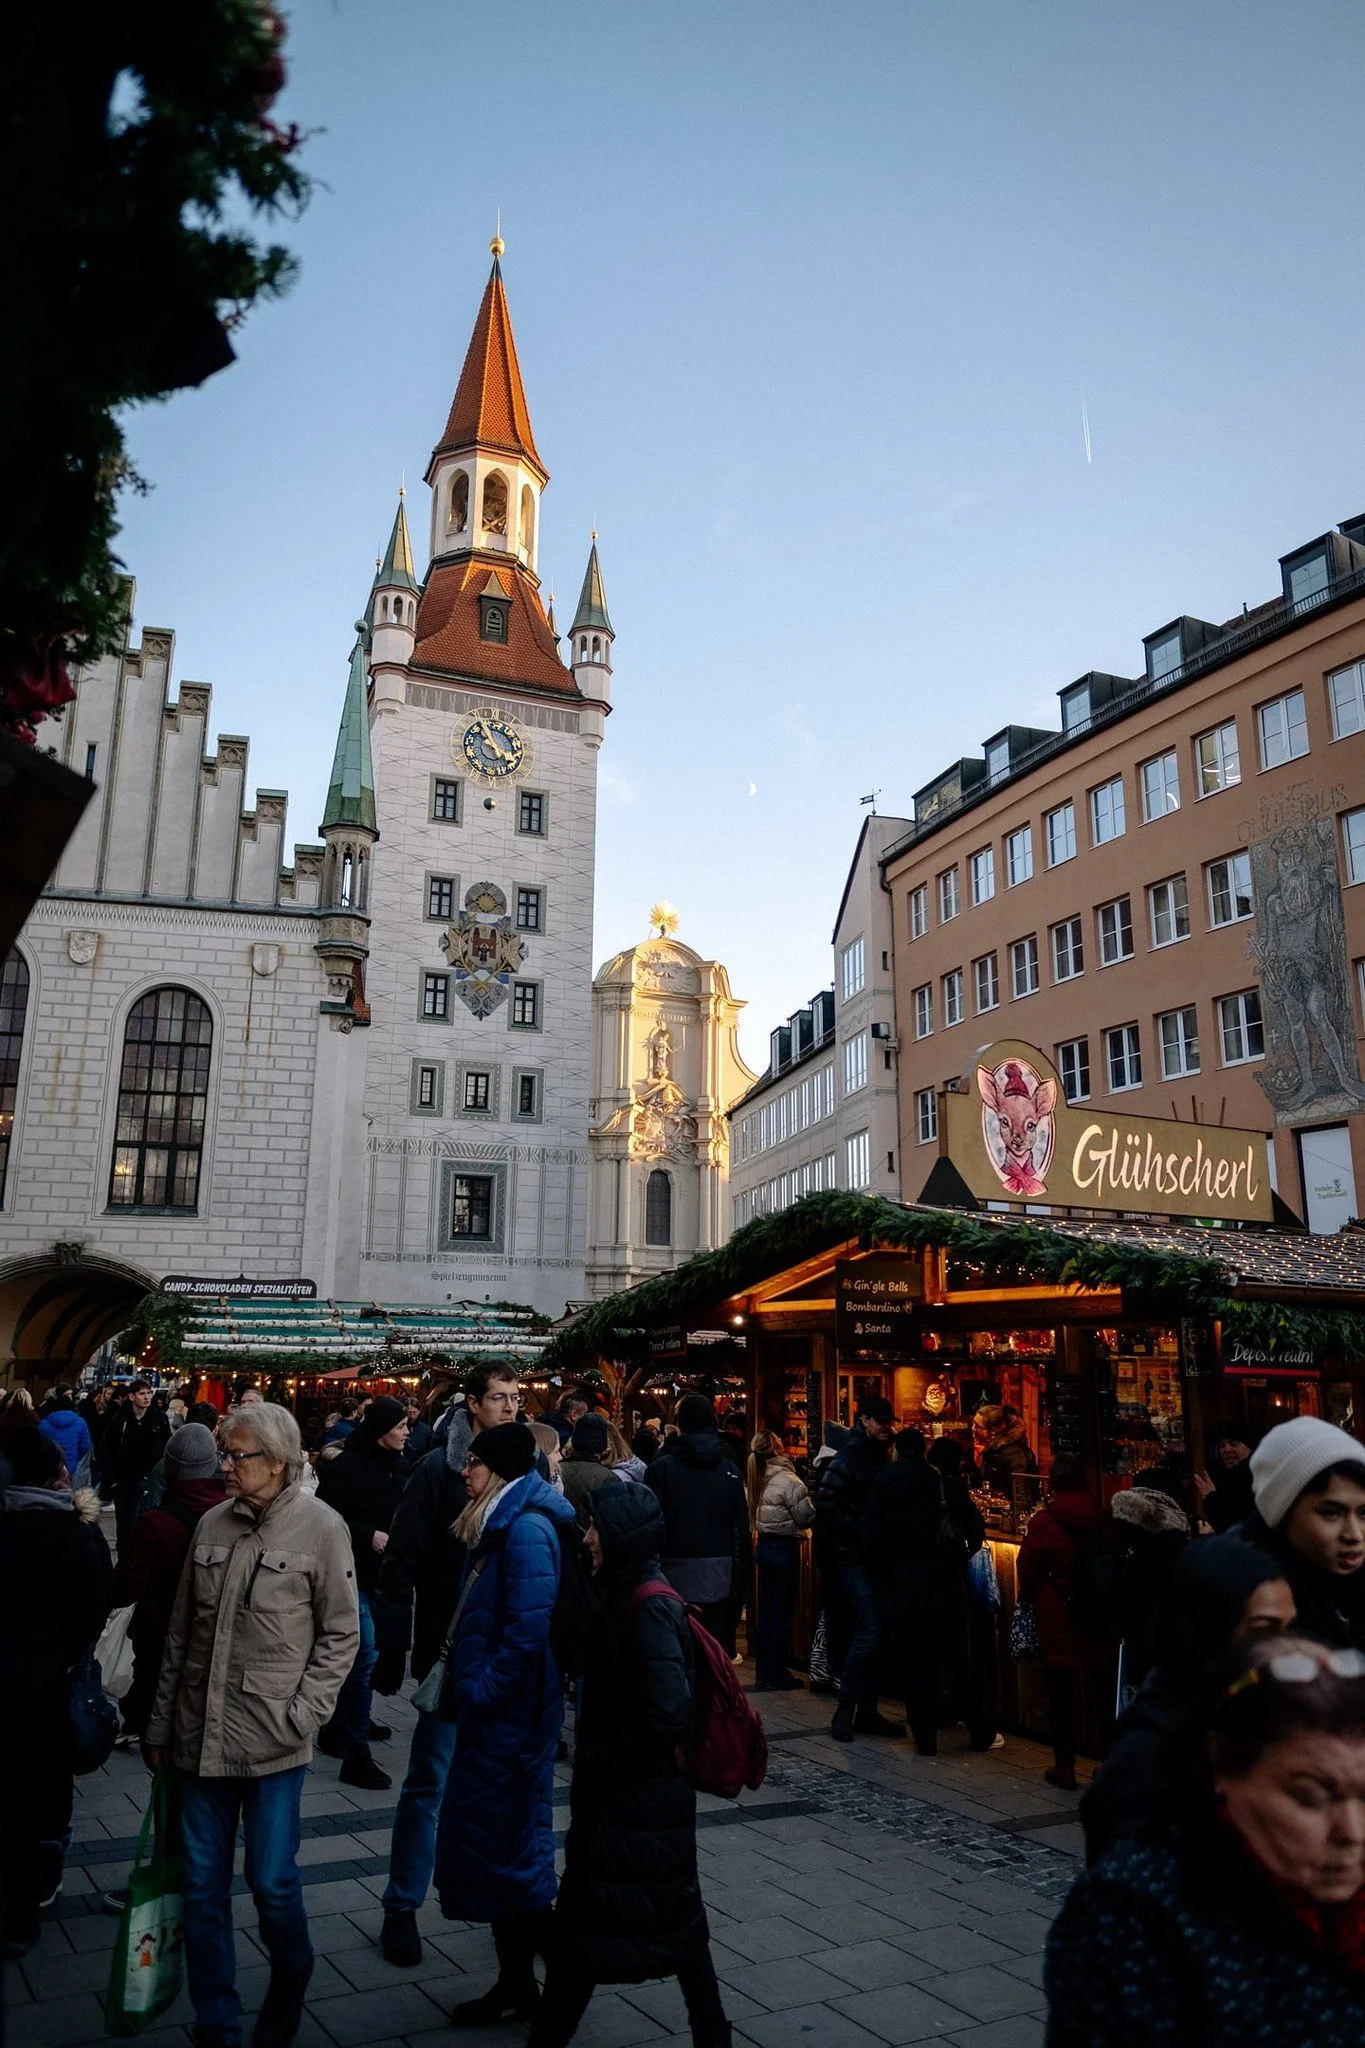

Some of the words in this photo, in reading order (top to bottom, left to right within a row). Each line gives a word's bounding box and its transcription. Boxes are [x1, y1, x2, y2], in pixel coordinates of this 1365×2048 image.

[1072, 1124, 1260, 1201] Glühscherl
[431, 1270, 507, 1283] Spielzeugmuseum
[164, 1281, 252, 1295] CANDY-SCHOKOLADEN
[252, 1283, 313, 1296] SPEZIALITÄTEN
[888, 1281, 909, 1292] Bells
[845, 1300, 901, 1313] Bombardino
[864, 1322, 892, 1334] Santa
